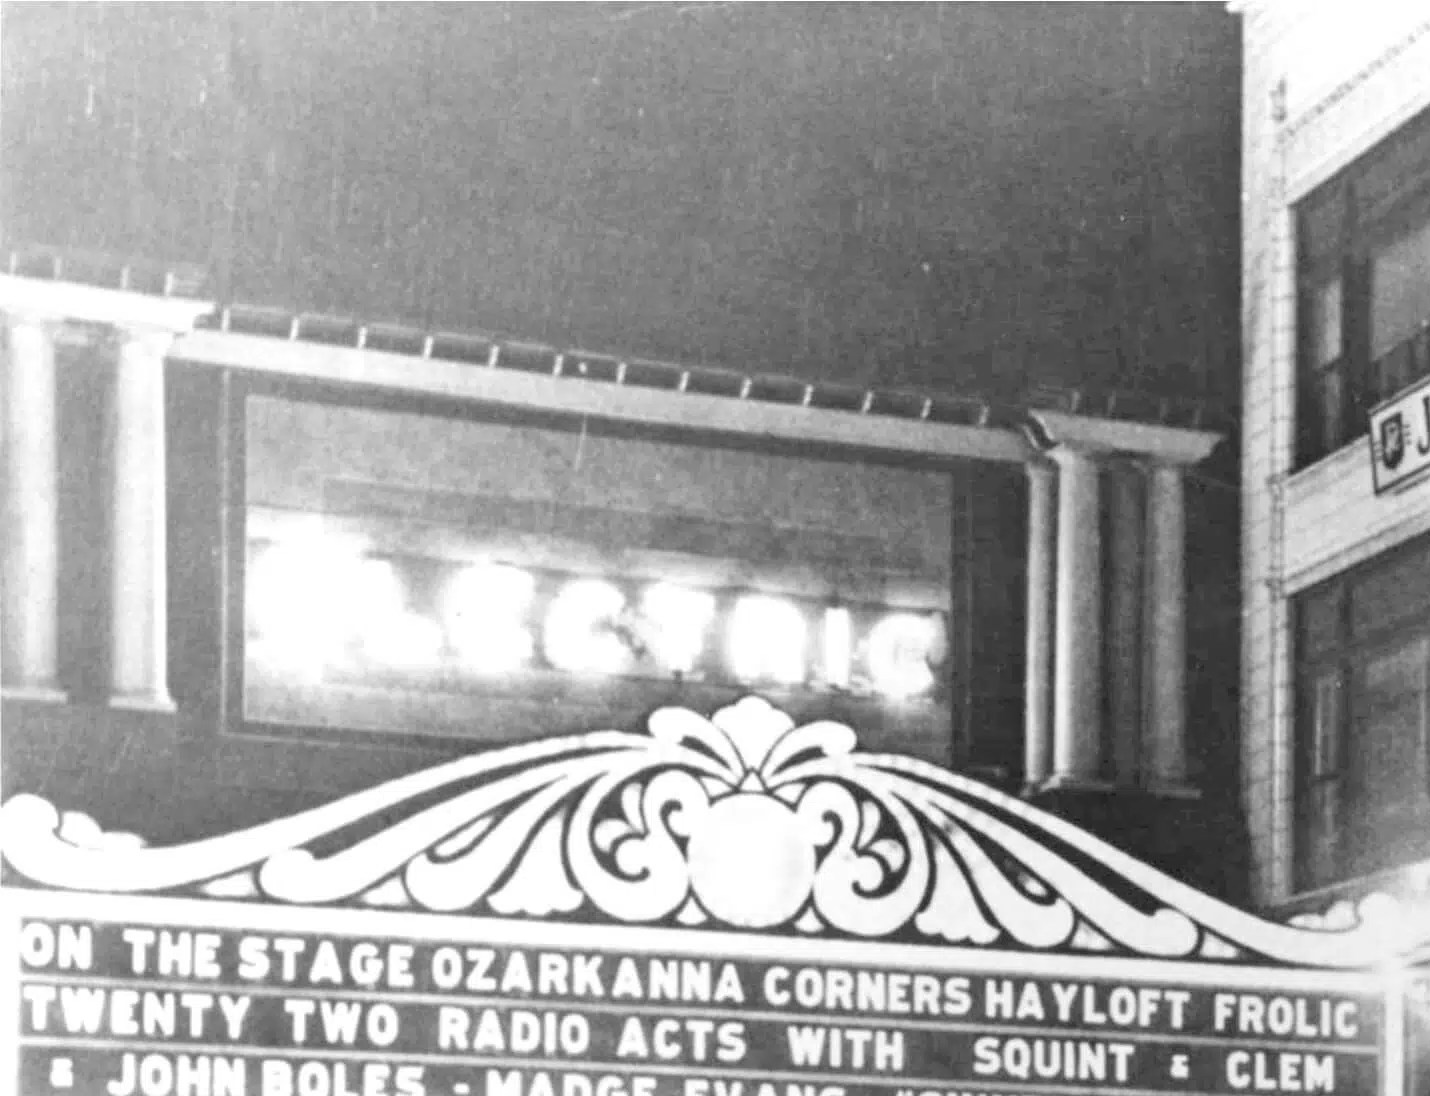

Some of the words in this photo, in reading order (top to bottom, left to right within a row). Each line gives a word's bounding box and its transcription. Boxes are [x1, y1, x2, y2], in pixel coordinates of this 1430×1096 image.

[247, 548, 946, 699] LECTRIC
[21, 921, 93, 970] ON
[122, 927, 221, 978] THE
[238, 935, 414, 989] STAGE
[763, 967, 971, 1015] CORNERS
[985, 980, 1191, 1030] HAYLOFT
[1214, 993, 1358, 1038] FROLIC
[21, 985, 251, 1040] TWENTY
[285, 1000, 399, 1046] TWO
[438, 1006, 590, 1055] RADIO
[616, 1016, 746, 1062] ACTS
[787, 1026, 904, 1071] WITH
[973, 1037, 1134, 1082] SQUINT
[1170, 1054, 1189, 1078] &
[1226, 1051, 1334, 1092] CLEM
